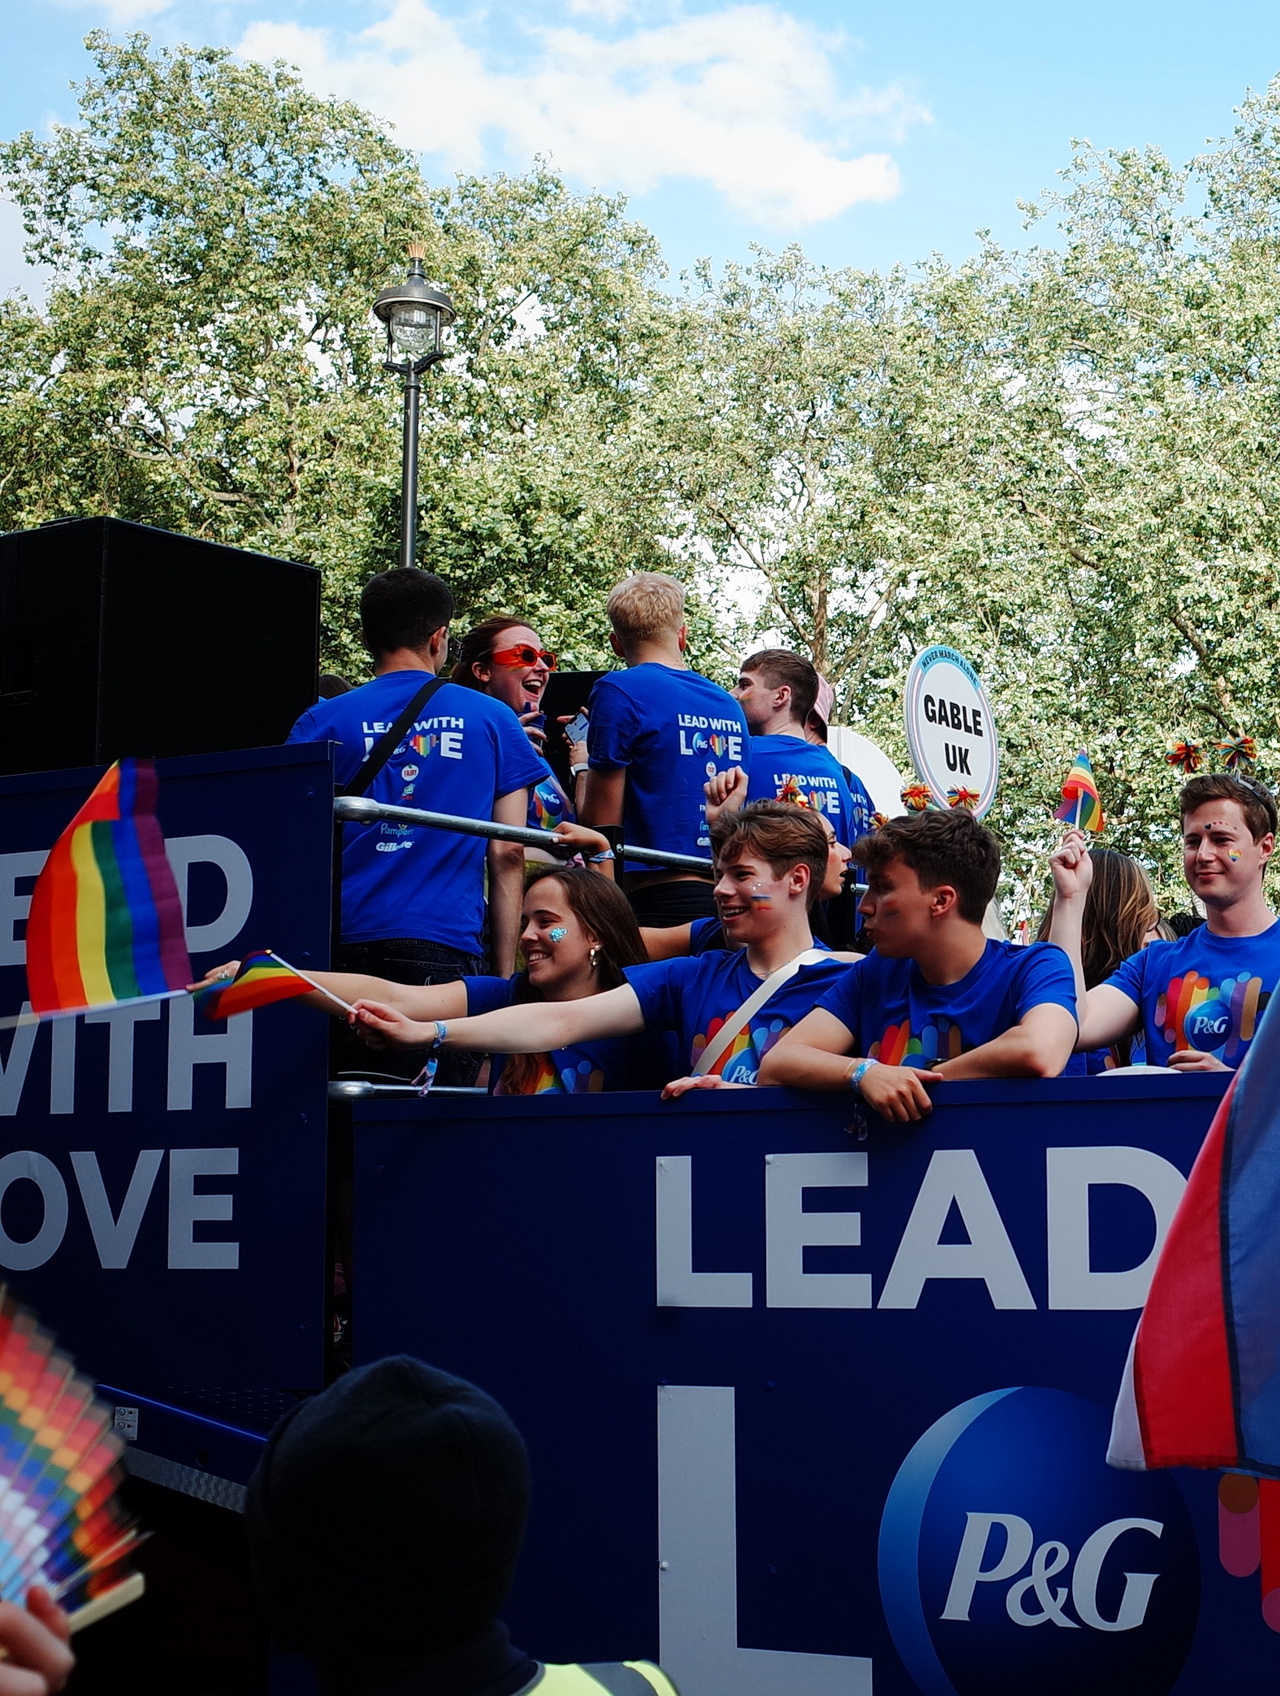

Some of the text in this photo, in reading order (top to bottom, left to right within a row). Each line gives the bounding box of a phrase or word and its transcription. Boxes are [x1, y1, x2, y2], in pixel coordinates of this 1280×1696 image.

[921, 649, 978, 687] NEVER MARCH ALONE
[413, 716, 464, 732] WITH
[677, 713, 742, 733] LEAD WITH
[923, 693, 984, 738] GABLE
[944, 742, 972, 776] UK
[806, 775, 838, 789] WITH
[0, 835, 253, 967] ED
[1193, 1016, 1229, 1035] P&G
[655, 1146, 1188, 1312] LEAD
[941, 1512, 1164, 1632] P&G
